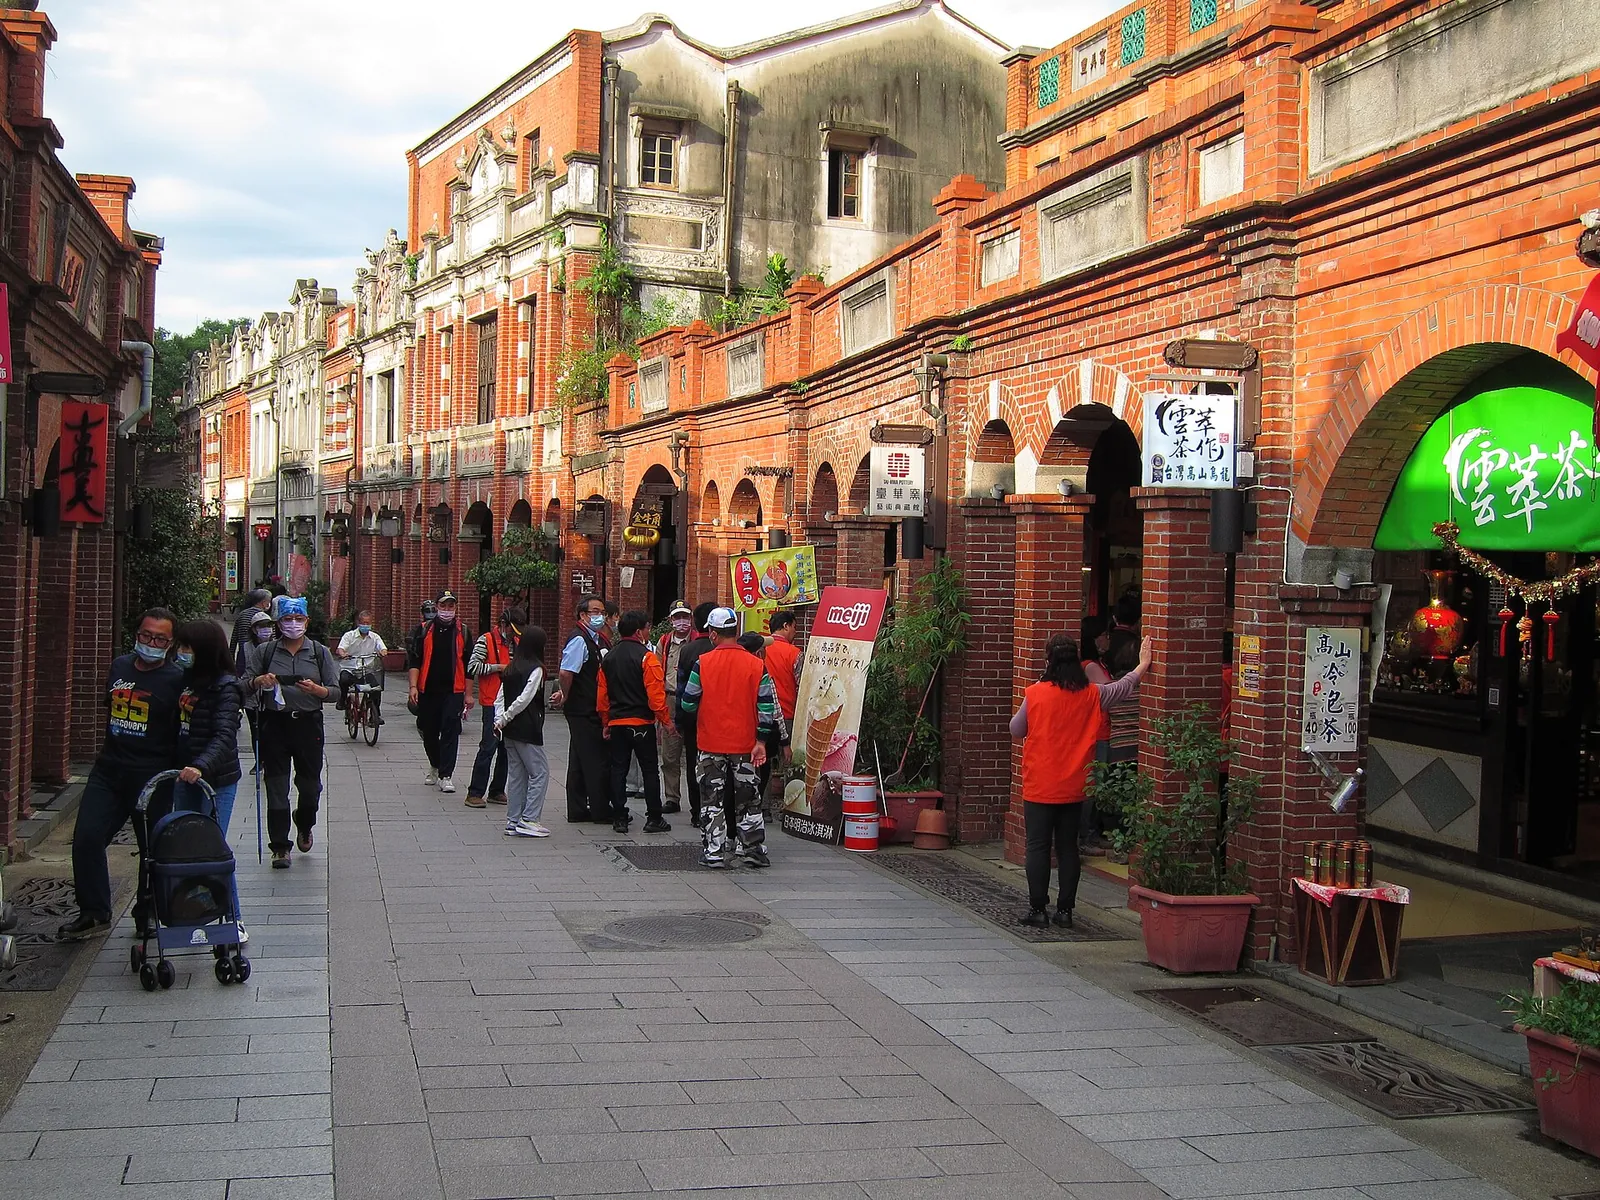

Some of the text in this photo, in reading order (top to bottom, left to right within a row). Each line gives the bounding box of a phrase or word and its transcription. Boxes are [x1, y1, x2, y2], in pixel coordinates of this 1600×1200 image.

[1168, 405, 1216, 437] 雲萃
[1169, 436, 1224, 462] 茶作
[1164, 465, 1231, 482] 台灣高山烏龍
[1462, 430, 1600, 533] 雲萃茶
[632, 511, 661, 527] 金牛角
[741, 561, 754, 605] 隨手一包
[827, 602, 871, 630] meiji
[110, 678, 136, 692] Since
[110, 688, 152, 723] 85
[784, 815, 834, 839] 日本明治冰淇淋
